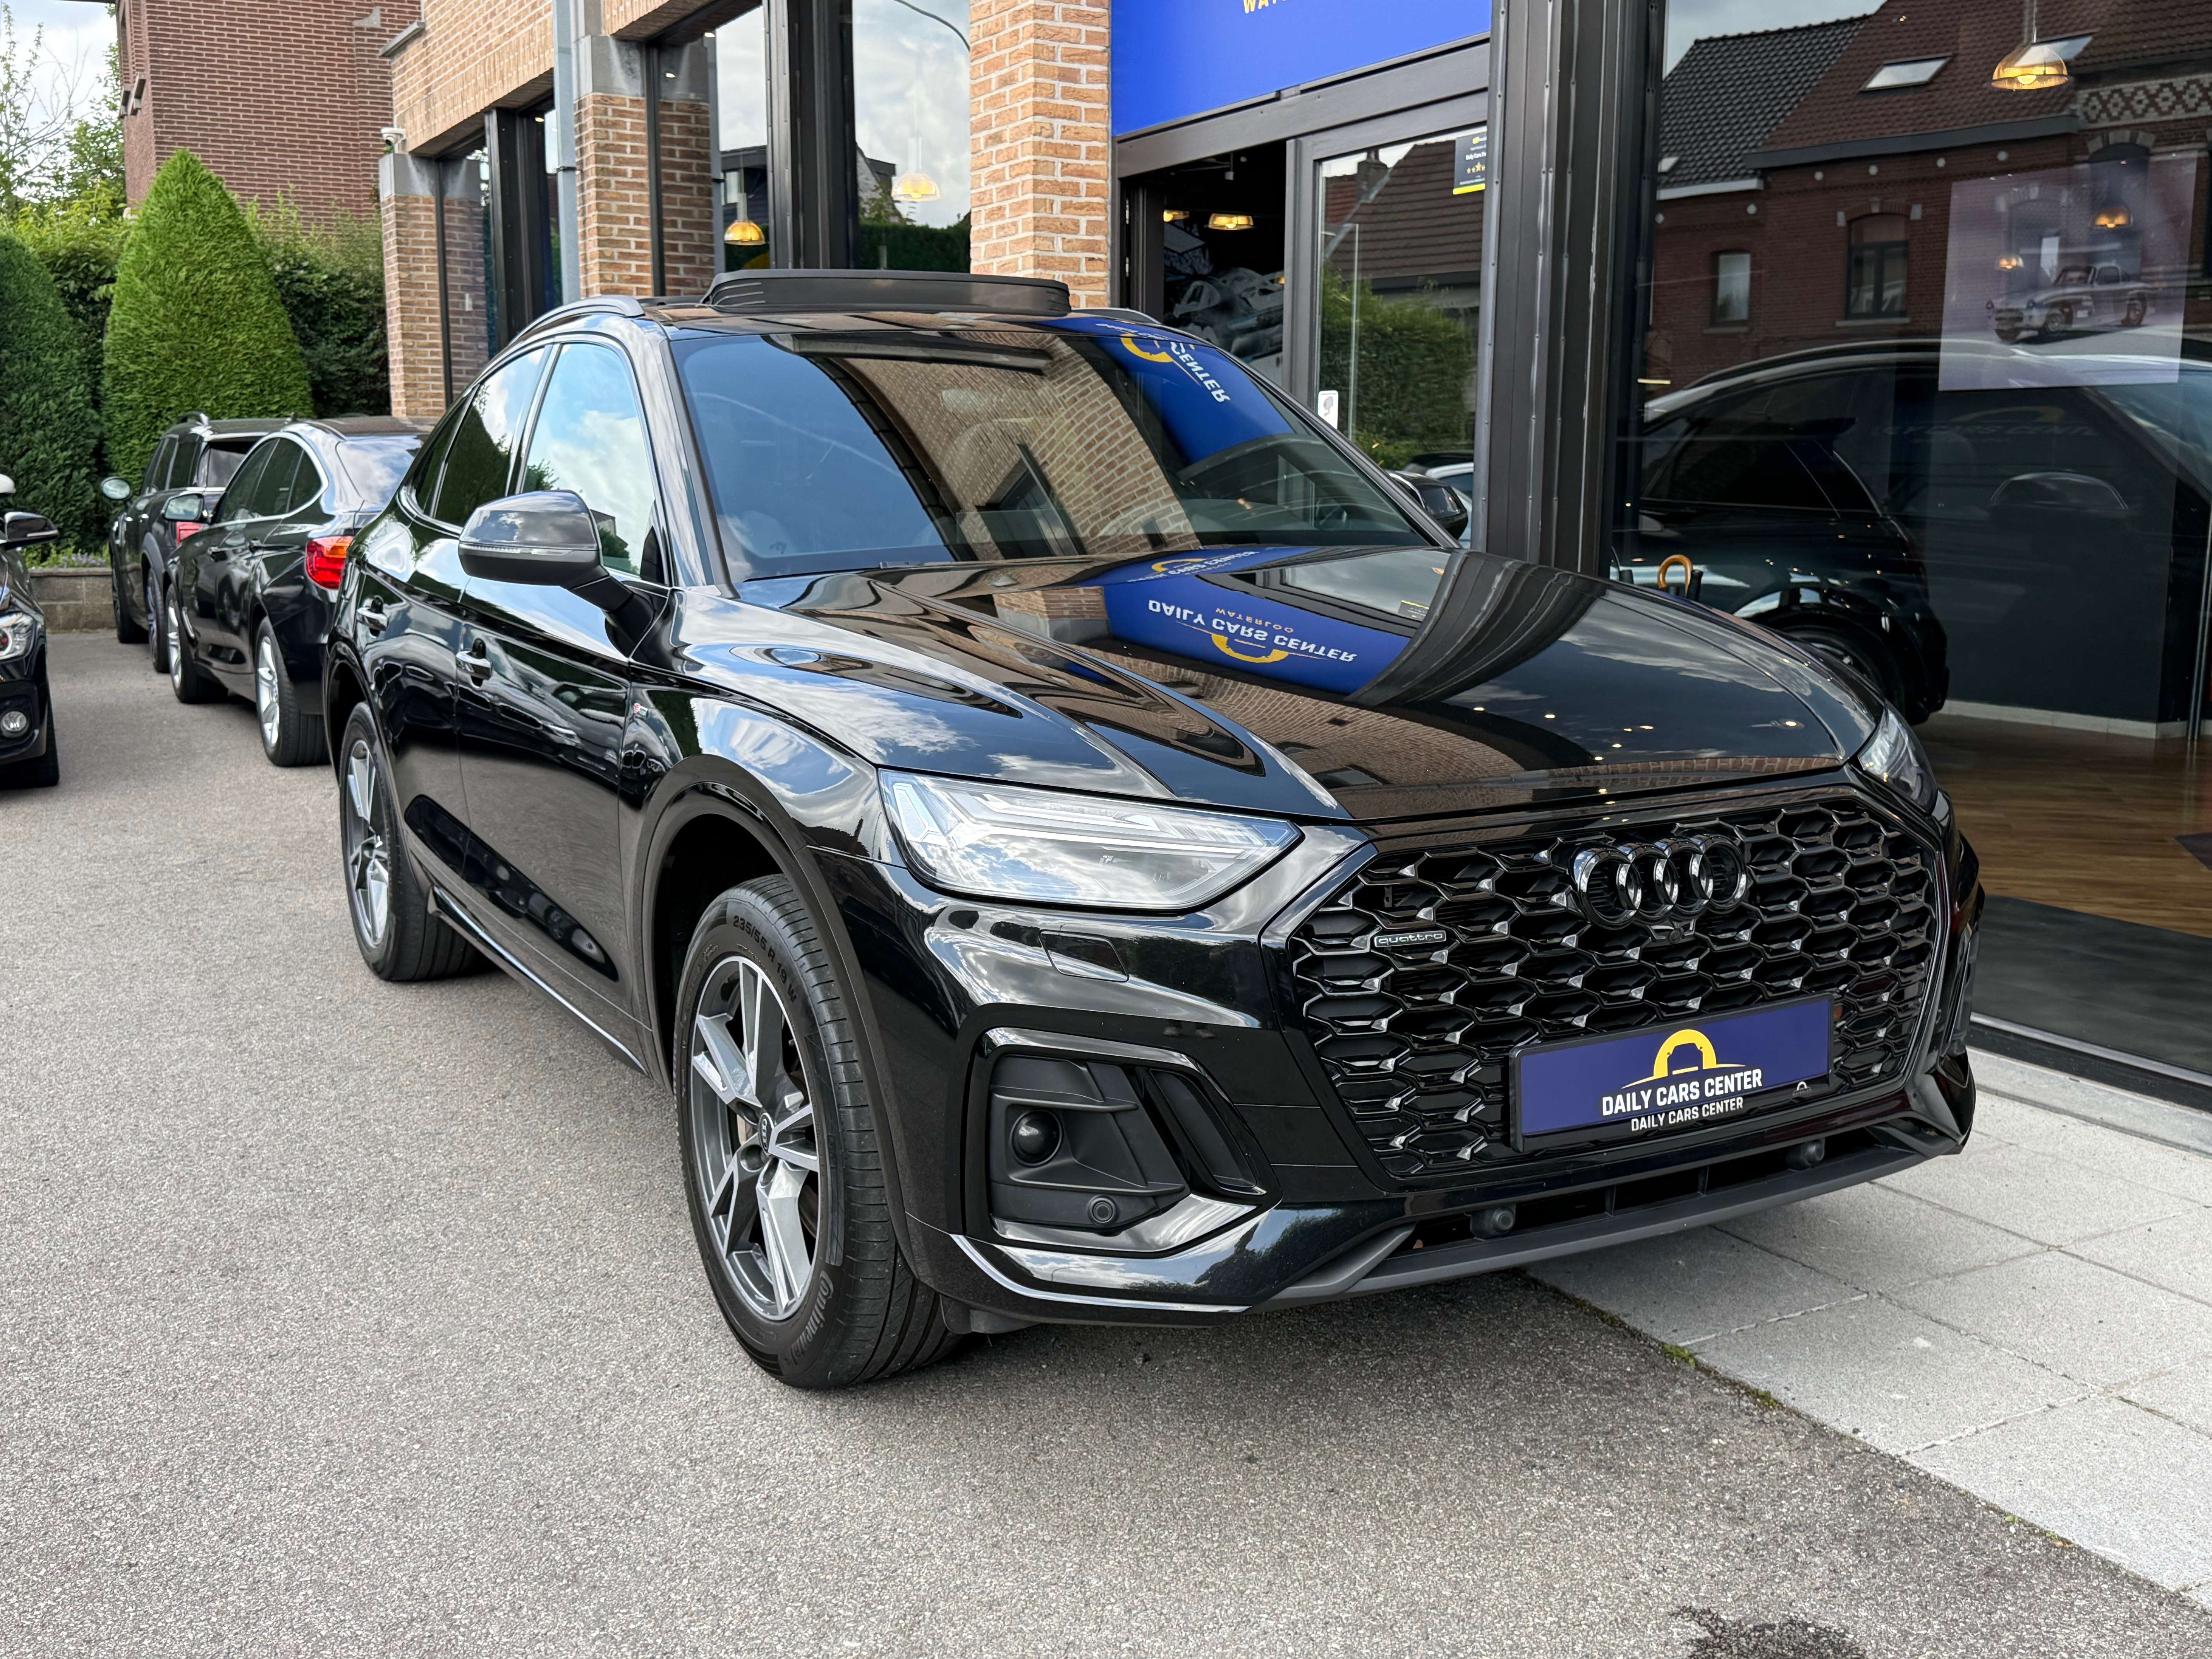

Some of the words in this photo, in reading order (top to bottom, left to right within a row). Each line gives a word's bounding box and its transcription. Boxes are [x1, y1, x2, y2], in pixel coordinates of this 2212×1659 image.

[733, 915, 767, 950] 235/55
[768, 946, 775, 963] R
[777, 962, 787, 984] 19
[1378, 933, 1443, 945] quattro
[1602, 1089, 1652, 1116] DAILY
[1656, 1081, 1700, 1106] CARS
[1705, 1068, 1762, 1097] CENTER
[1631, 1112, 1665, 1132] DAILY
[1668, 1106, 1699, 1124] CARS
[1702, 1097, 1743, 1117] CENTER
[790, 1270, 834, 1365] Continental
